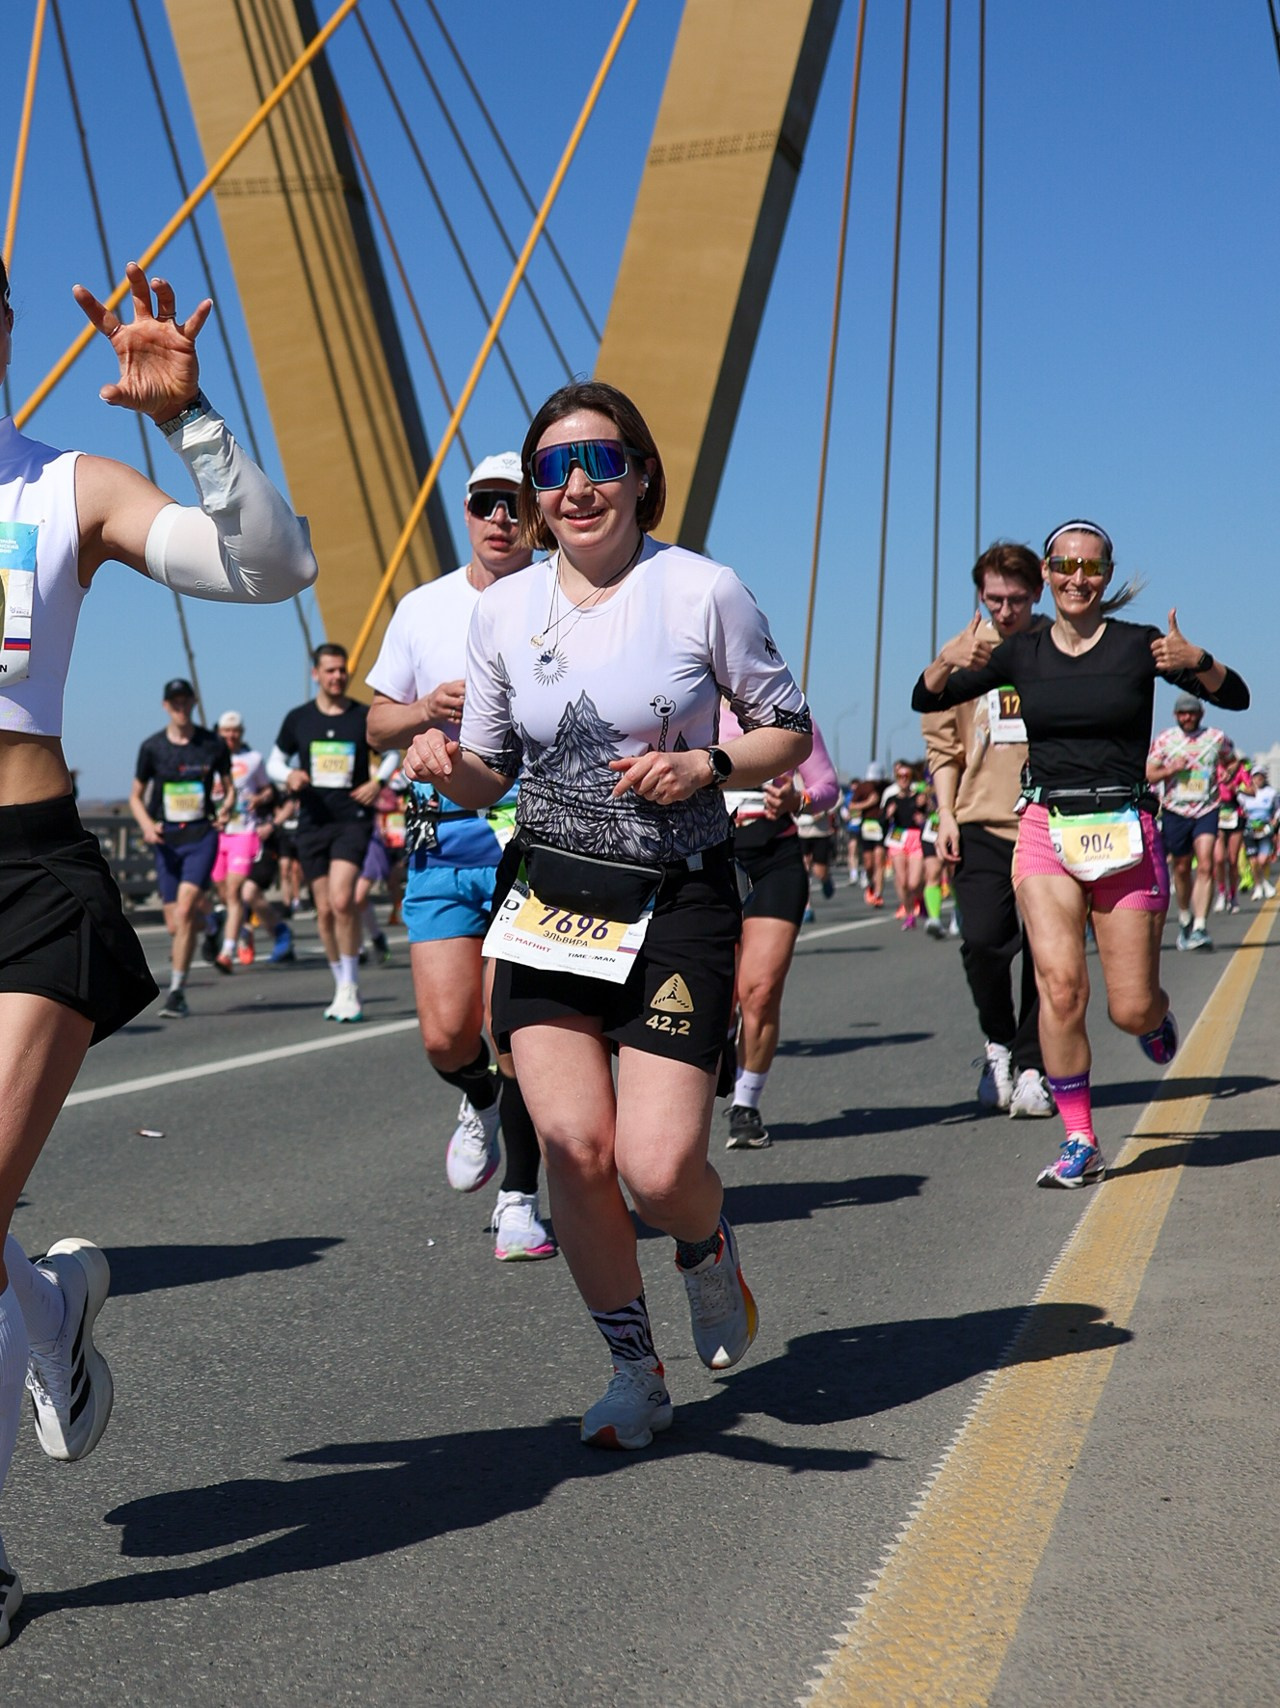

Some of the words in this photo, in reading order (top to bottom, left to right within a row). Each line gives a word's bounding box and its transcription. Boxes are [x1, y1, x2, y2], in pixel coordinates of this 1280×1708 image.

[1080, 832, 1114, 854] 904
[538, 905, 609, 940] 7696
[515, 936, 552, 953] МАГНИТ
[542, 929, 589, 947] ЭЛЬВИРА
[645, 1014, 691, 1036] 42,2
